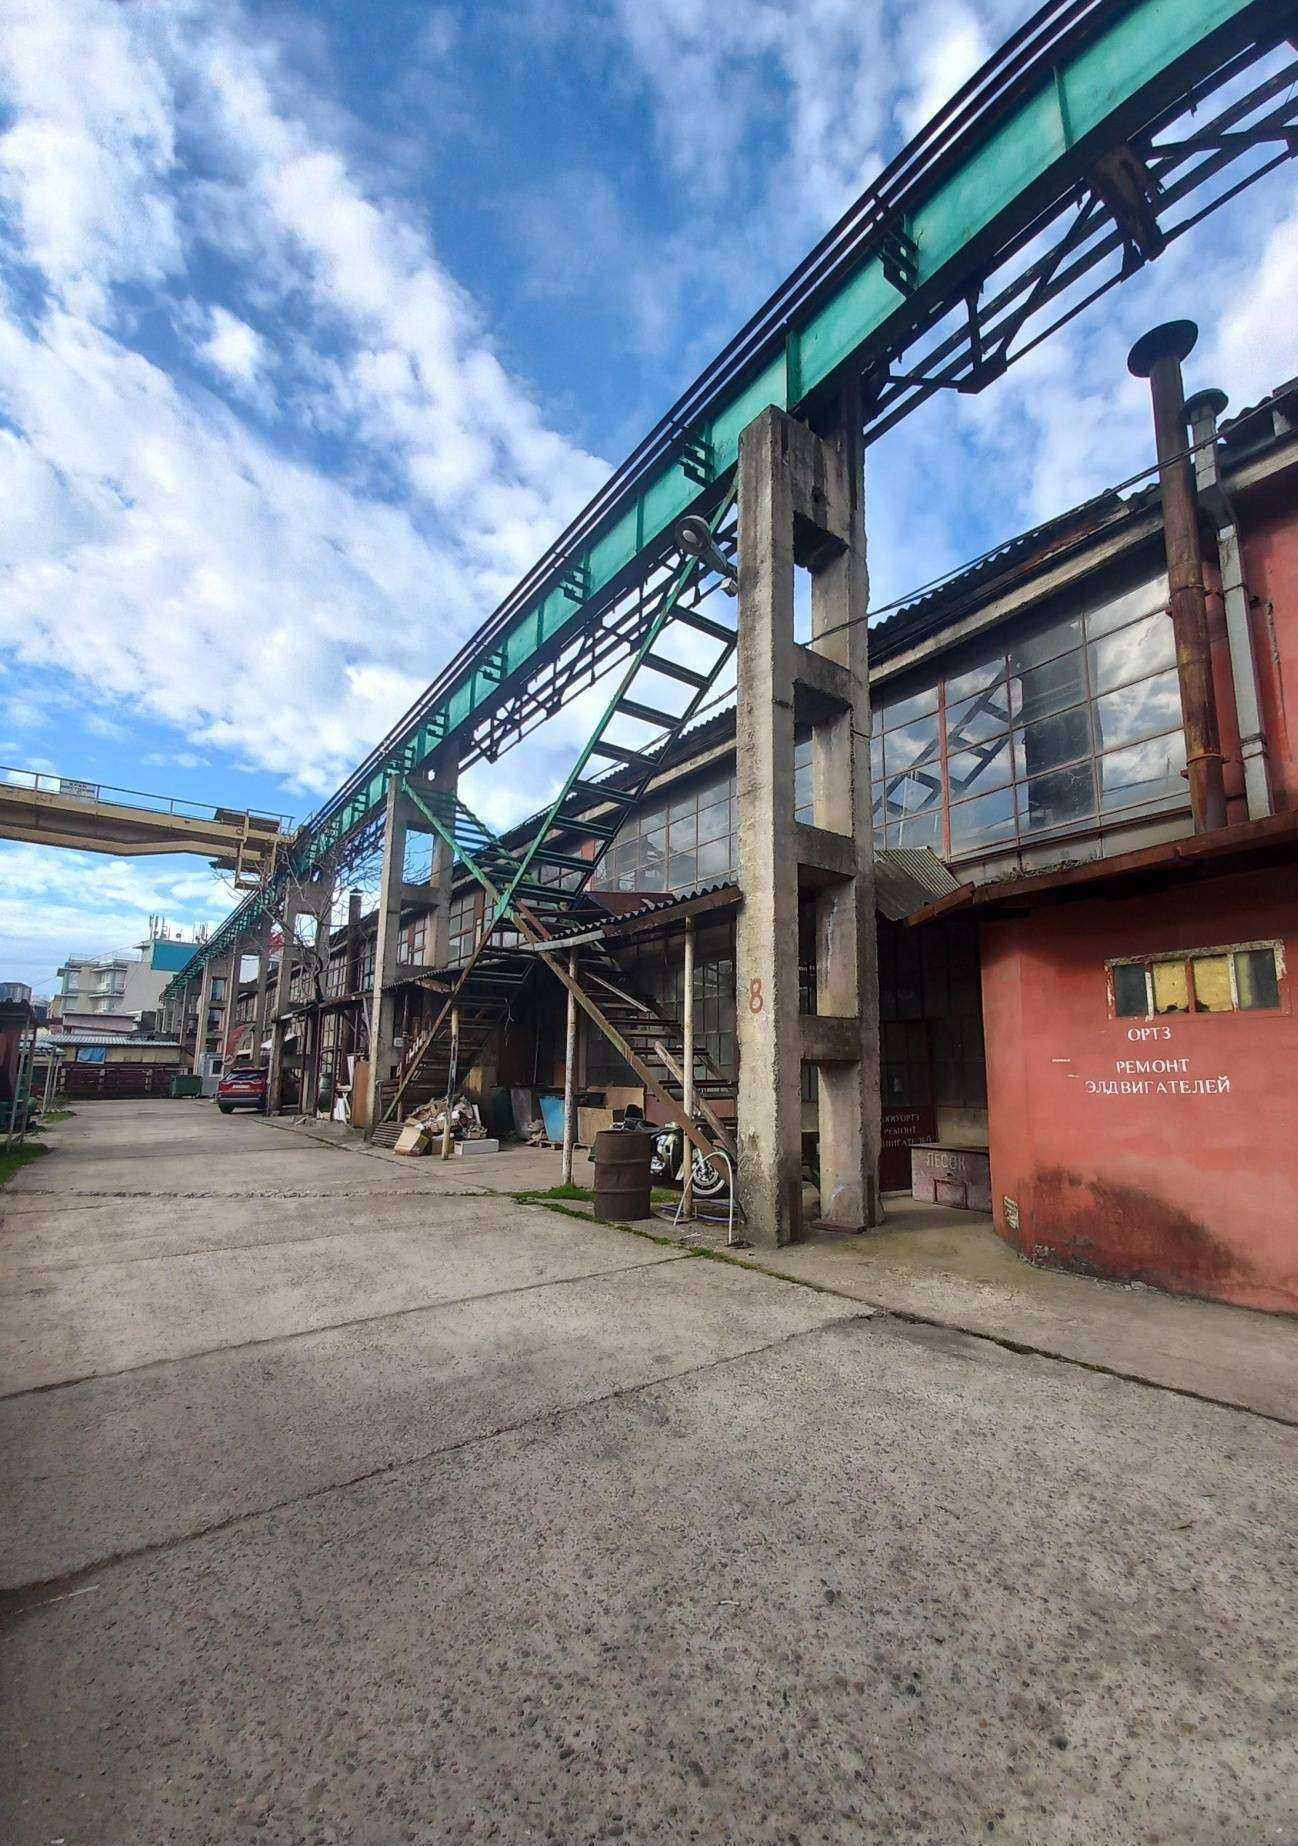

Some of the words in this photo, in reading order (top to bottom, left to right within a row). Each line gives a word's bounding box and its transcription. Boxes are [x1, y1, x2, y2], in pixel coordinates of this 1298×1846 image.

[749, 977, 763, 1013] 8
[1116, 1059, 1190, 1074] РЕМОНТ
[1085, 1075, 1231, 1095] ЭЛДВИГАТЕЛЕЙ
